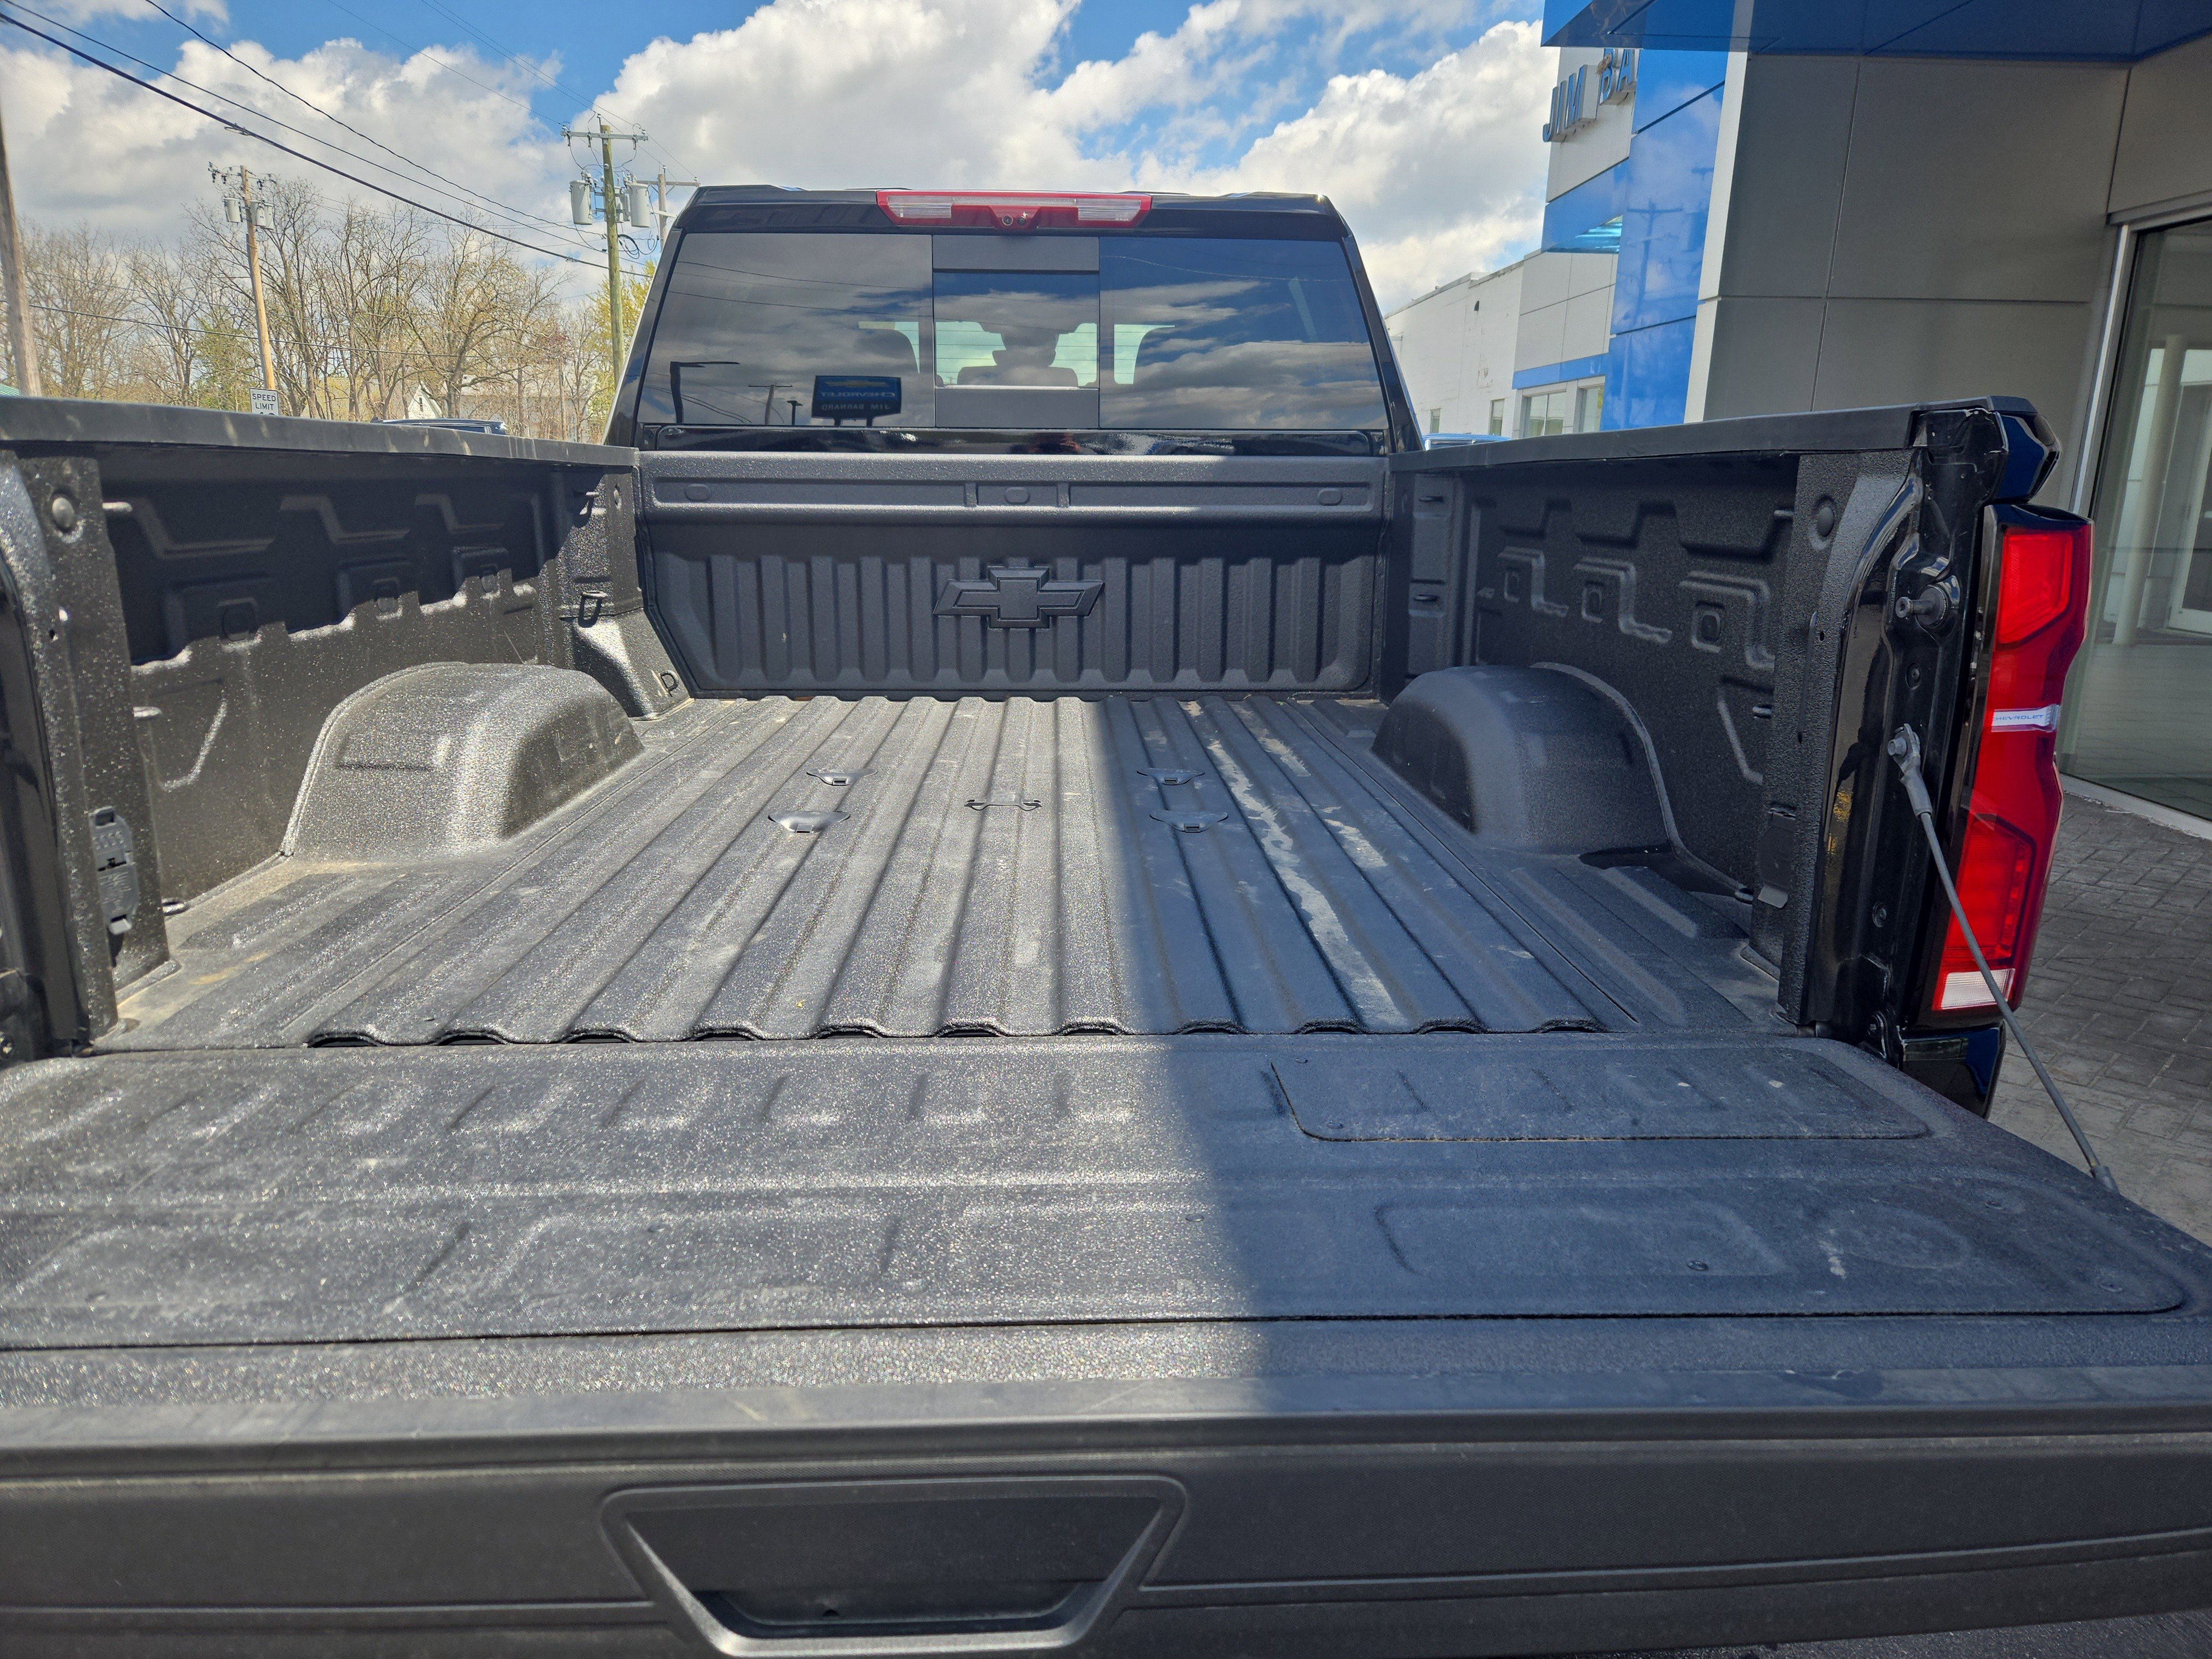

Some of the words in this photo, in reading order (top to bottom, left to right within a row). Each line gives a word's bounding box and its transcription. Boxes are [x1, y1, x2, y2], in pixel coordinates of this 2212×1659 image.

[1542, 65, 1589, 143] JIM
[252, 393, 276, 402] SPEED
[255, 402, 274, 410] LIMIT
